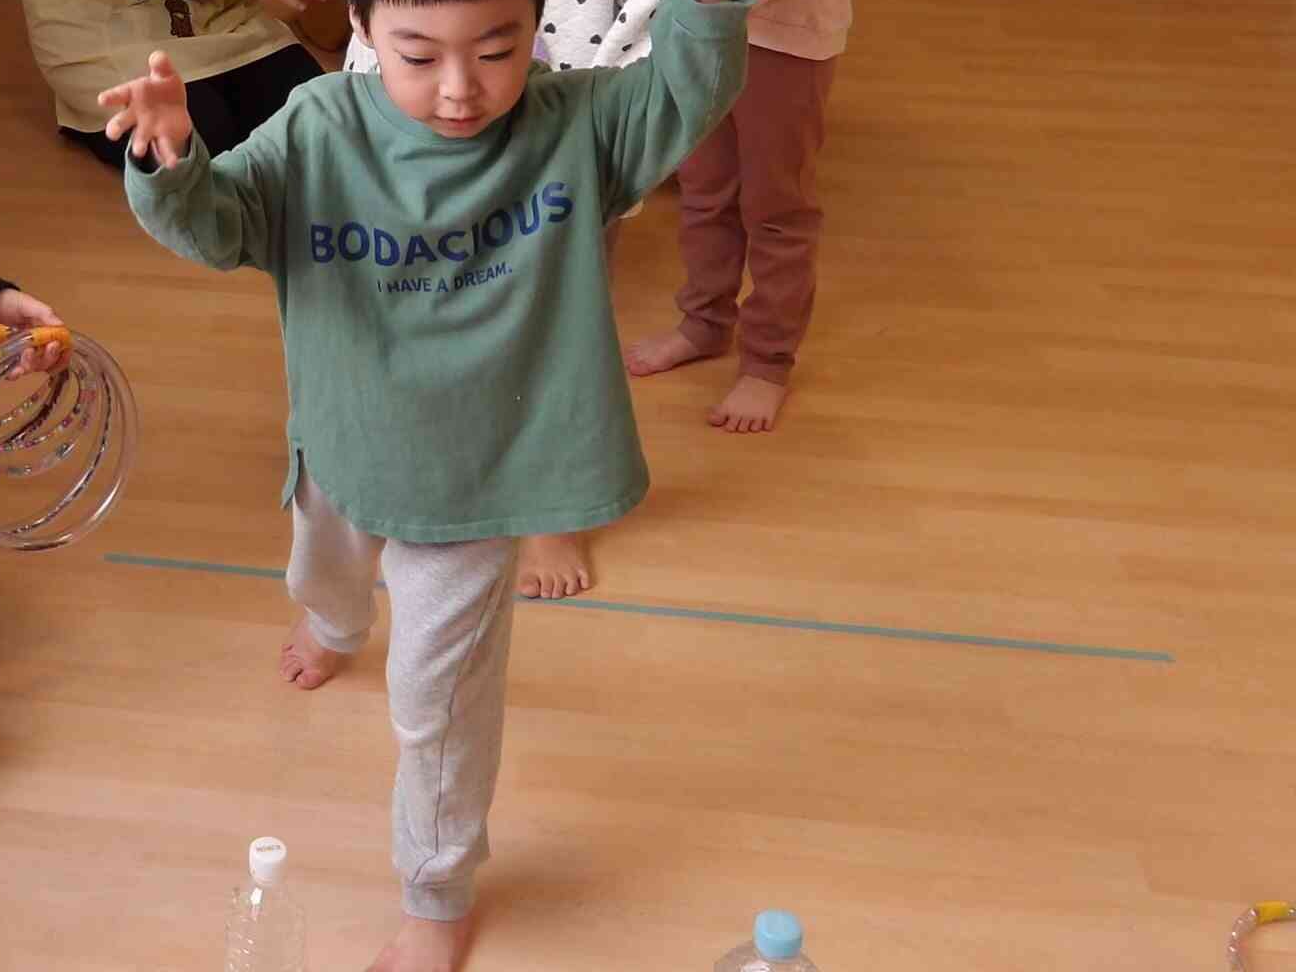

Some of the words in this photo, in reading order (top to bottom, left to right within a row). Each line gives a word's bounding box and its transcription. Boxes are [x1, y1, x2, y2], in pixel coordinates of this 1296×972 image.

[310, 181, 574, 267] BODACIOUS
[377, 279, 383, 293] I
[387, 278, 433, 293] HAVE
[437, 279, 449, 293] A
[454, 261, 513, 290] DREAM.
